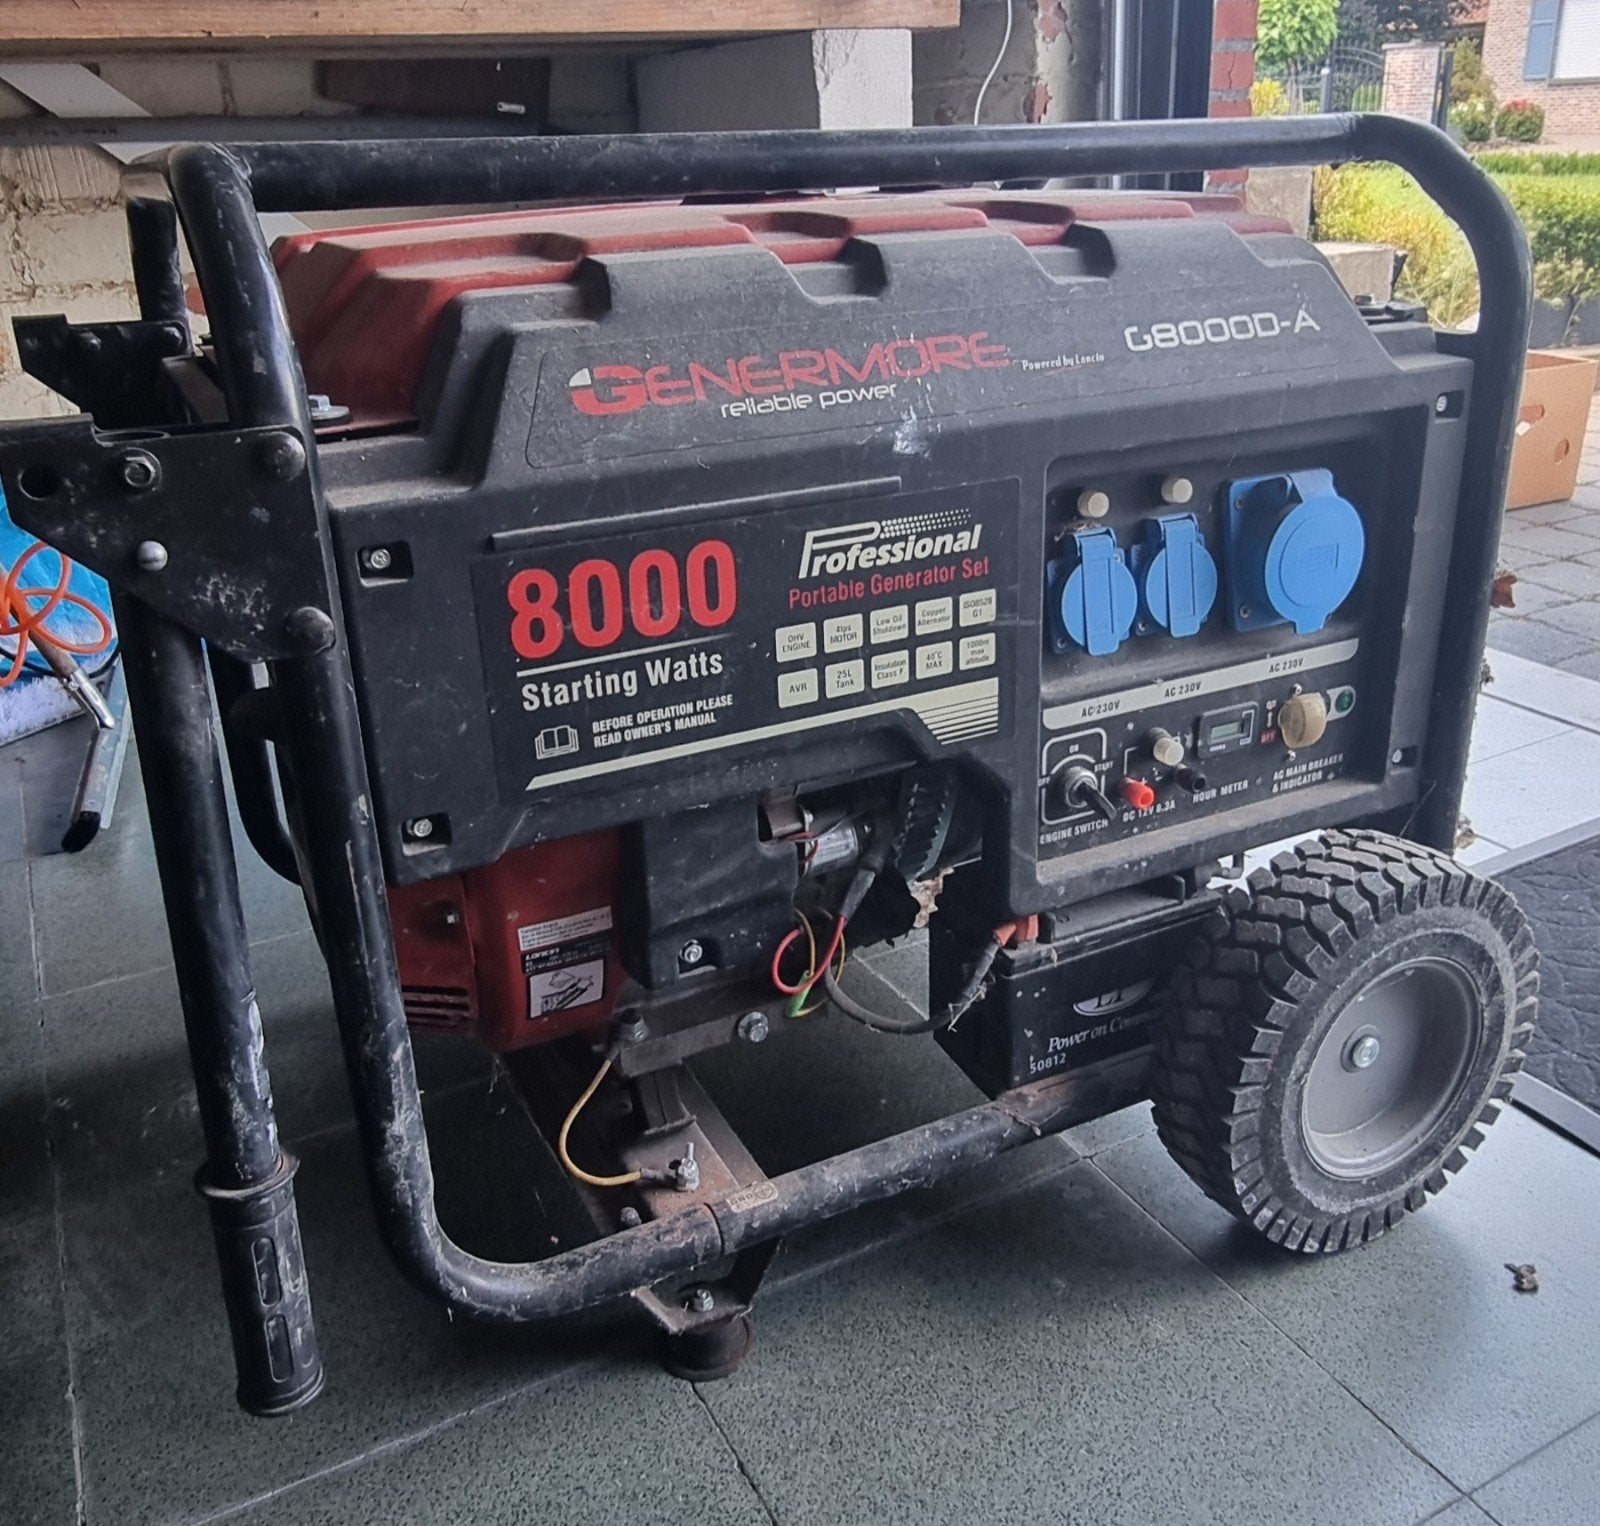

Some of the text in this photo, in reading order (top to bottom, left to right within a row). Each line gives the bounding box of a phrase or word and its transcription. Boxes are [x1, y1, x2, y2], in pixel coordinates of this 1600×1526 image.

[1124, 308, 1321, 352] G8000D-A
[1022, 354, 1061, 371] Powered
[1063, 354, 1074, 368] by
[568, 331, 1010, 416] GENERMORE
[721, 382, 898, 419] reliable power
[798, 521, 983, 579] Professional
[788, 555, 990, 610] Portable Generator Set
[507, 539, 738, 660] 8000
[876, 617, 890, 626] Low
[782, 641, 811, 653] ENGINE
[830, 632, 857, 644] MOTOR
[836, 669, 852, 679] 25L
[876, 670, 897, 680] Class
[926, 660, 943, 670] MAX
[1269, 657, 1304, 674] AC 230V
[521, 651, 724, 712] Starting Watts
[789, 682, 808, 694] AVR
[836, 679, 855, 689] Tank
[1164, 681, 1202, 698] AC 230V
[592, 694, 734, 735] BEFORE OPERATION PLEASE
[1081, 700, 1121, 718] AC 230V
[594, 712, 717, 748] READ OWNER'S MANUAL
[1273, 752, 1344, 781] AC MAIN BREAKER
[1193, 779, 1249, 804] HOUR METER
[1280, 770, 1323, 792] INDICATOR
[1122, 810, 1136, 822] DC
[1040, 818, 1109, 845] ENGINE SWITCH
[1048, 1028, 1090, 1053] Power
[1090, 1024, 1108, 1040] on
[1029, 1053, 1067, 1074] 50812
